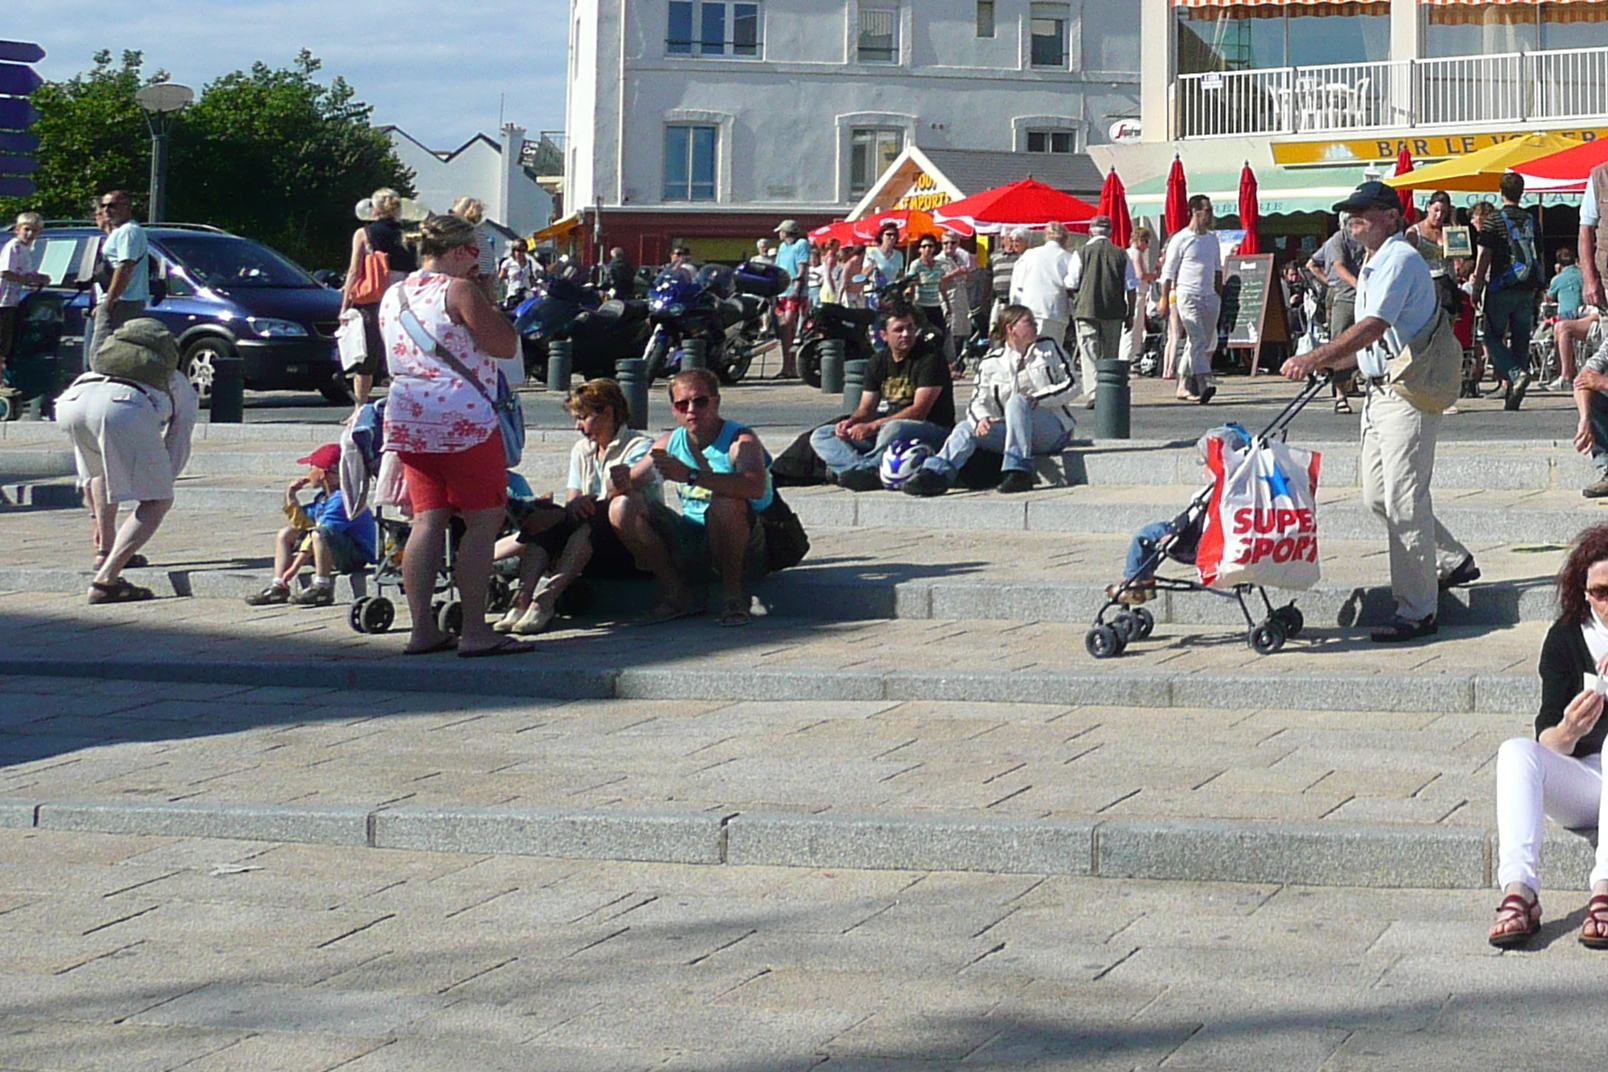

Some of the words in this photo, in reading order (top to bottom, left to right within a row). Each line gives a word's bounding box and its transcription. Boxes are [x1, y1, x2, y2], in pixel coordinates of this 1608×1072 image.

[1377, 140, 1430, 158] BAR
[1446, 137, 1478, 154] LE
[1233, 507, 1317, 535] SUPE
